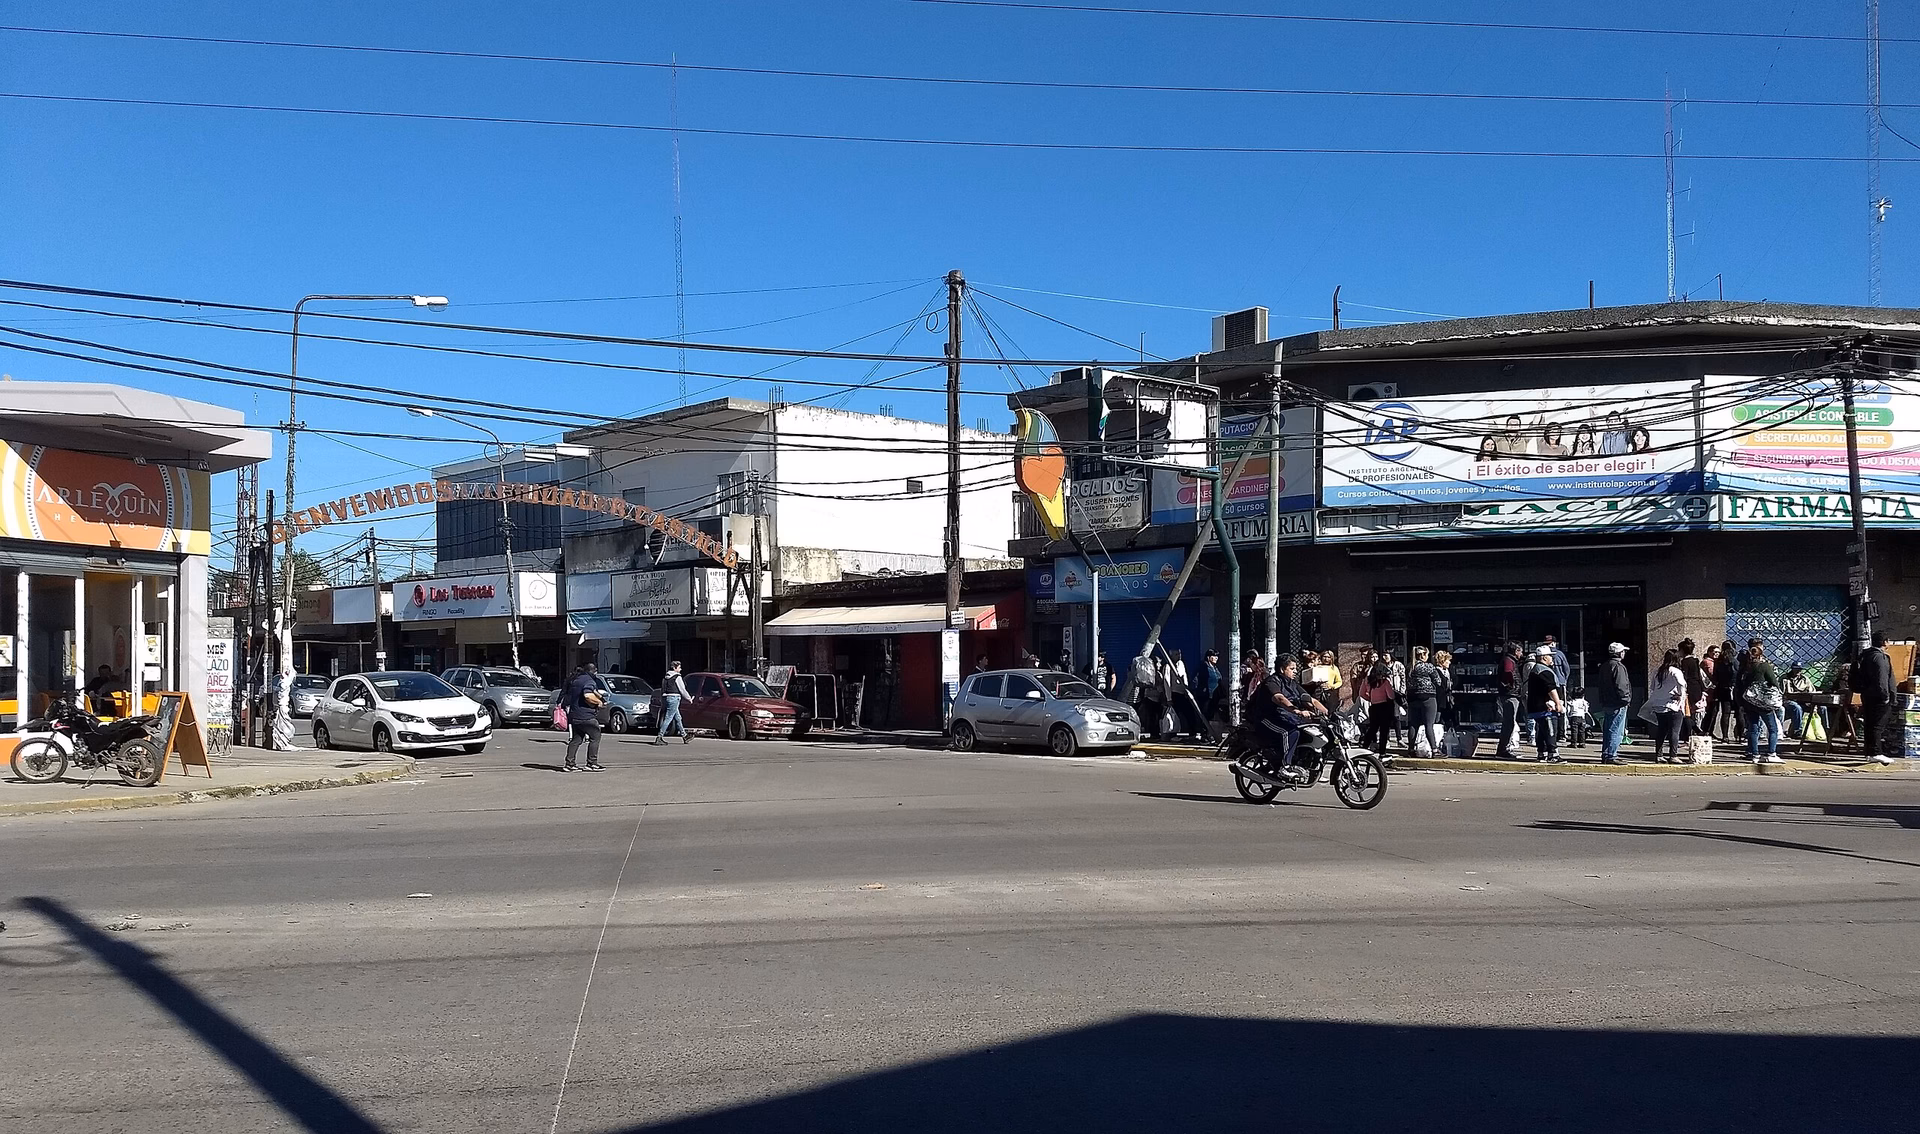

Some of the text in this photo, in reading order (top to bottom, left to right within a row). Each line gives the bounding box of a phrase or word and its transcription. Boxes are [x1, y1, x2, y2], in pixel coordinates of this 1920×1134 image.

[1754, 411, 1814, 423] ASISTENTE
[1364, 417, 1419, 444] IAP
[1754, 432, 1831, 443] SECRETARIADO
[1754, 453, 1816, 465] SECUNDARIO
[1879, 458, 1887, 466] A
[1476, 465, 1490, 477] El
[1494, 464, 1530, 476] éxito
[1535, 462, 1553, 474] de
[1557, 461, 1600, 474] saber
[1604, 459, 1647, 474] elegir
[1652, 458, 1656, 470] !
[1363, 473, 1434, 482] PROFESIONALES
[1811, 478, 1848, 487] cursos
[1338, 491, 1367, 499] Cursos
[1396, 489, 1417, 498] para
[1418, 485, 1444, 497] niños,
[1445, 487, 1479, 496] jovenes
[1085, 496, 1140, 506] SUSPENSIONES
[1225, 505, 1235, 515] 50
[1237, 503, 1265, 512] cursos
[54, 514, 149, 531] HELADOS
[1107, 563, 1148, 576] AMORES
[630, 607, 675, 616] DIGITAL
